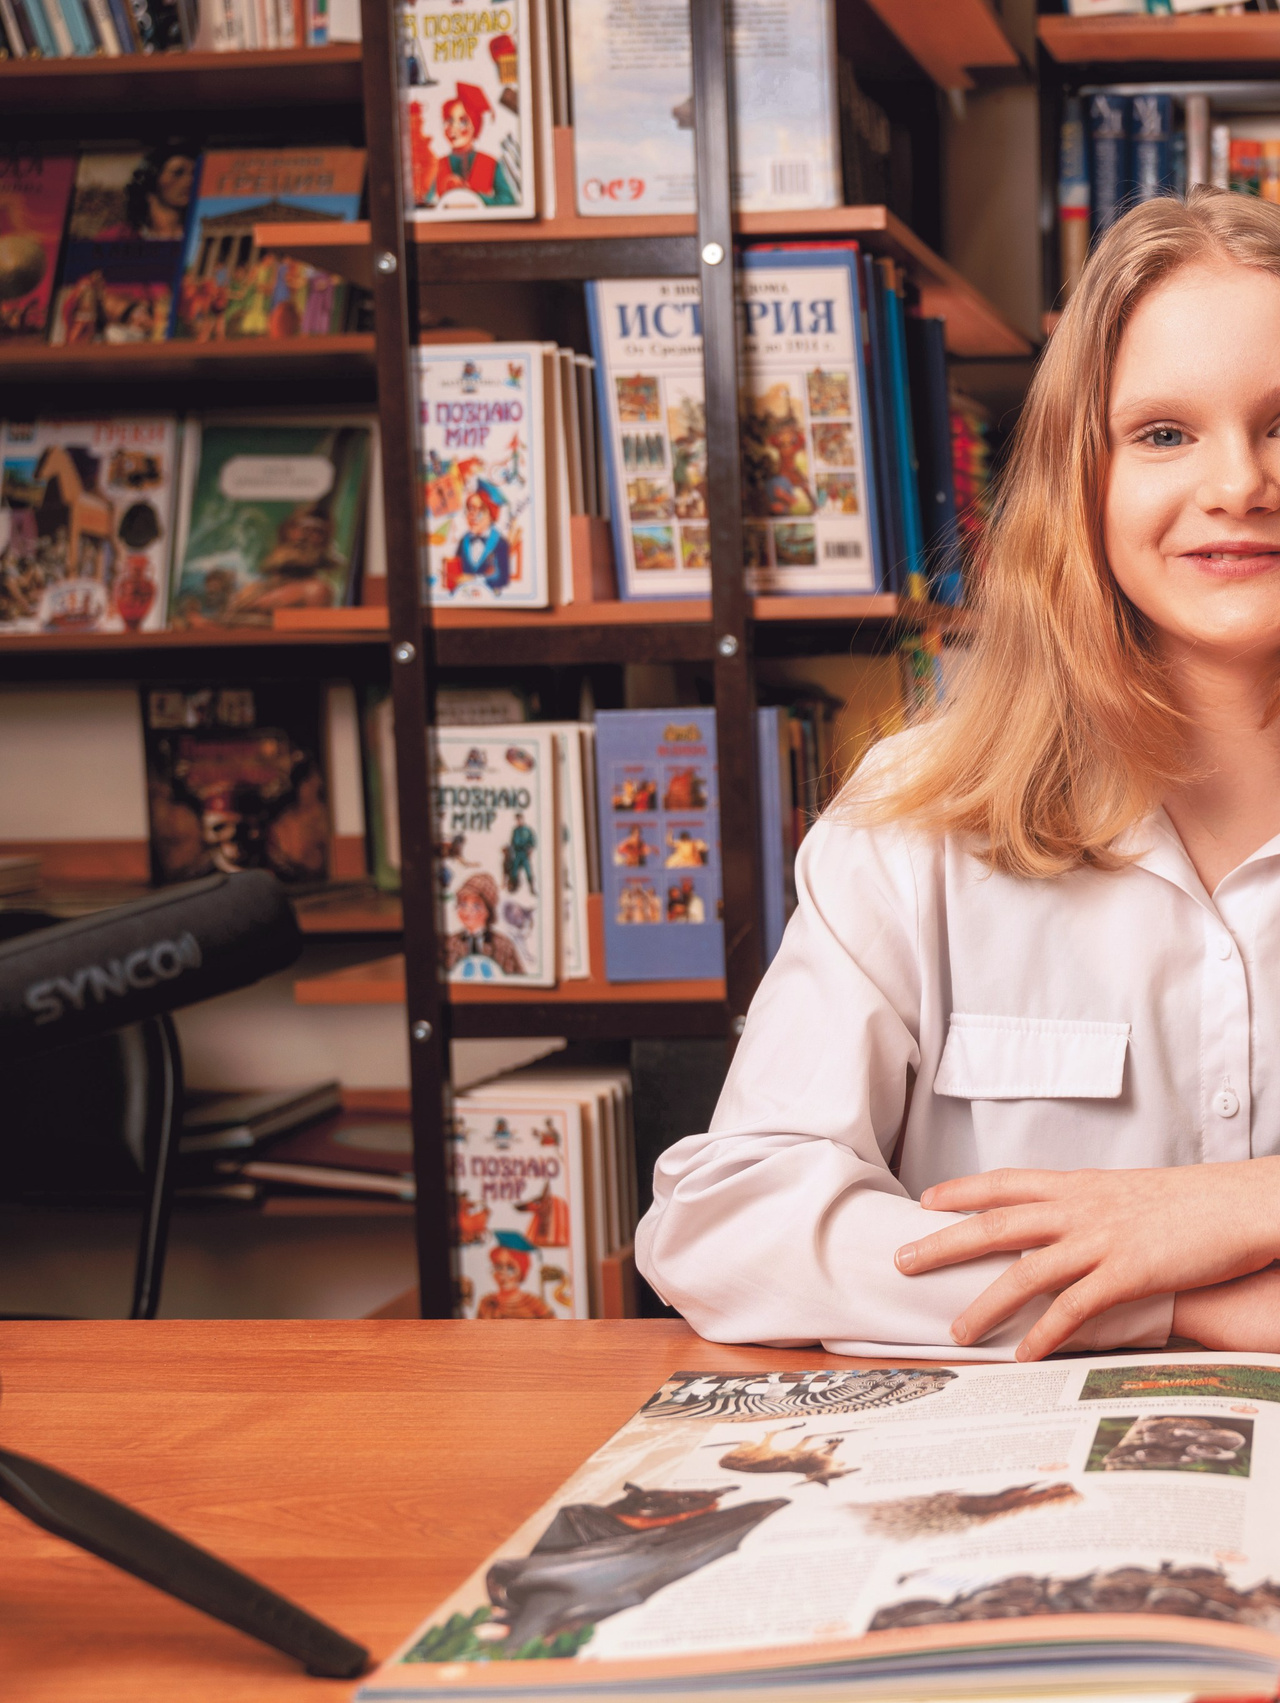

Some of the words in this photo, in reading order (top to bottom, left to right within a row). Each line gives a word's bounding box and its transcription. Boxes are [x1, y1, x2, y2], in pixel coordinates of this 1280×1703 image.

[424, 9, 513, 38] ПОЗНАЮ
[433, 36, 479, 63] МИР
[616, 299, 837, 339] ИСТРИЯ
[436, 400, 523, 426] ПОЗНАЮ
[444, 426, 491, 448] МИР
[450, 811, 497, 833] МИР
[25, 939, 184, 1027] SYNCO
[470, 1155, 560, 1179] ПОЗНАЮ
[481, 1178, 528, 1202] МИР
